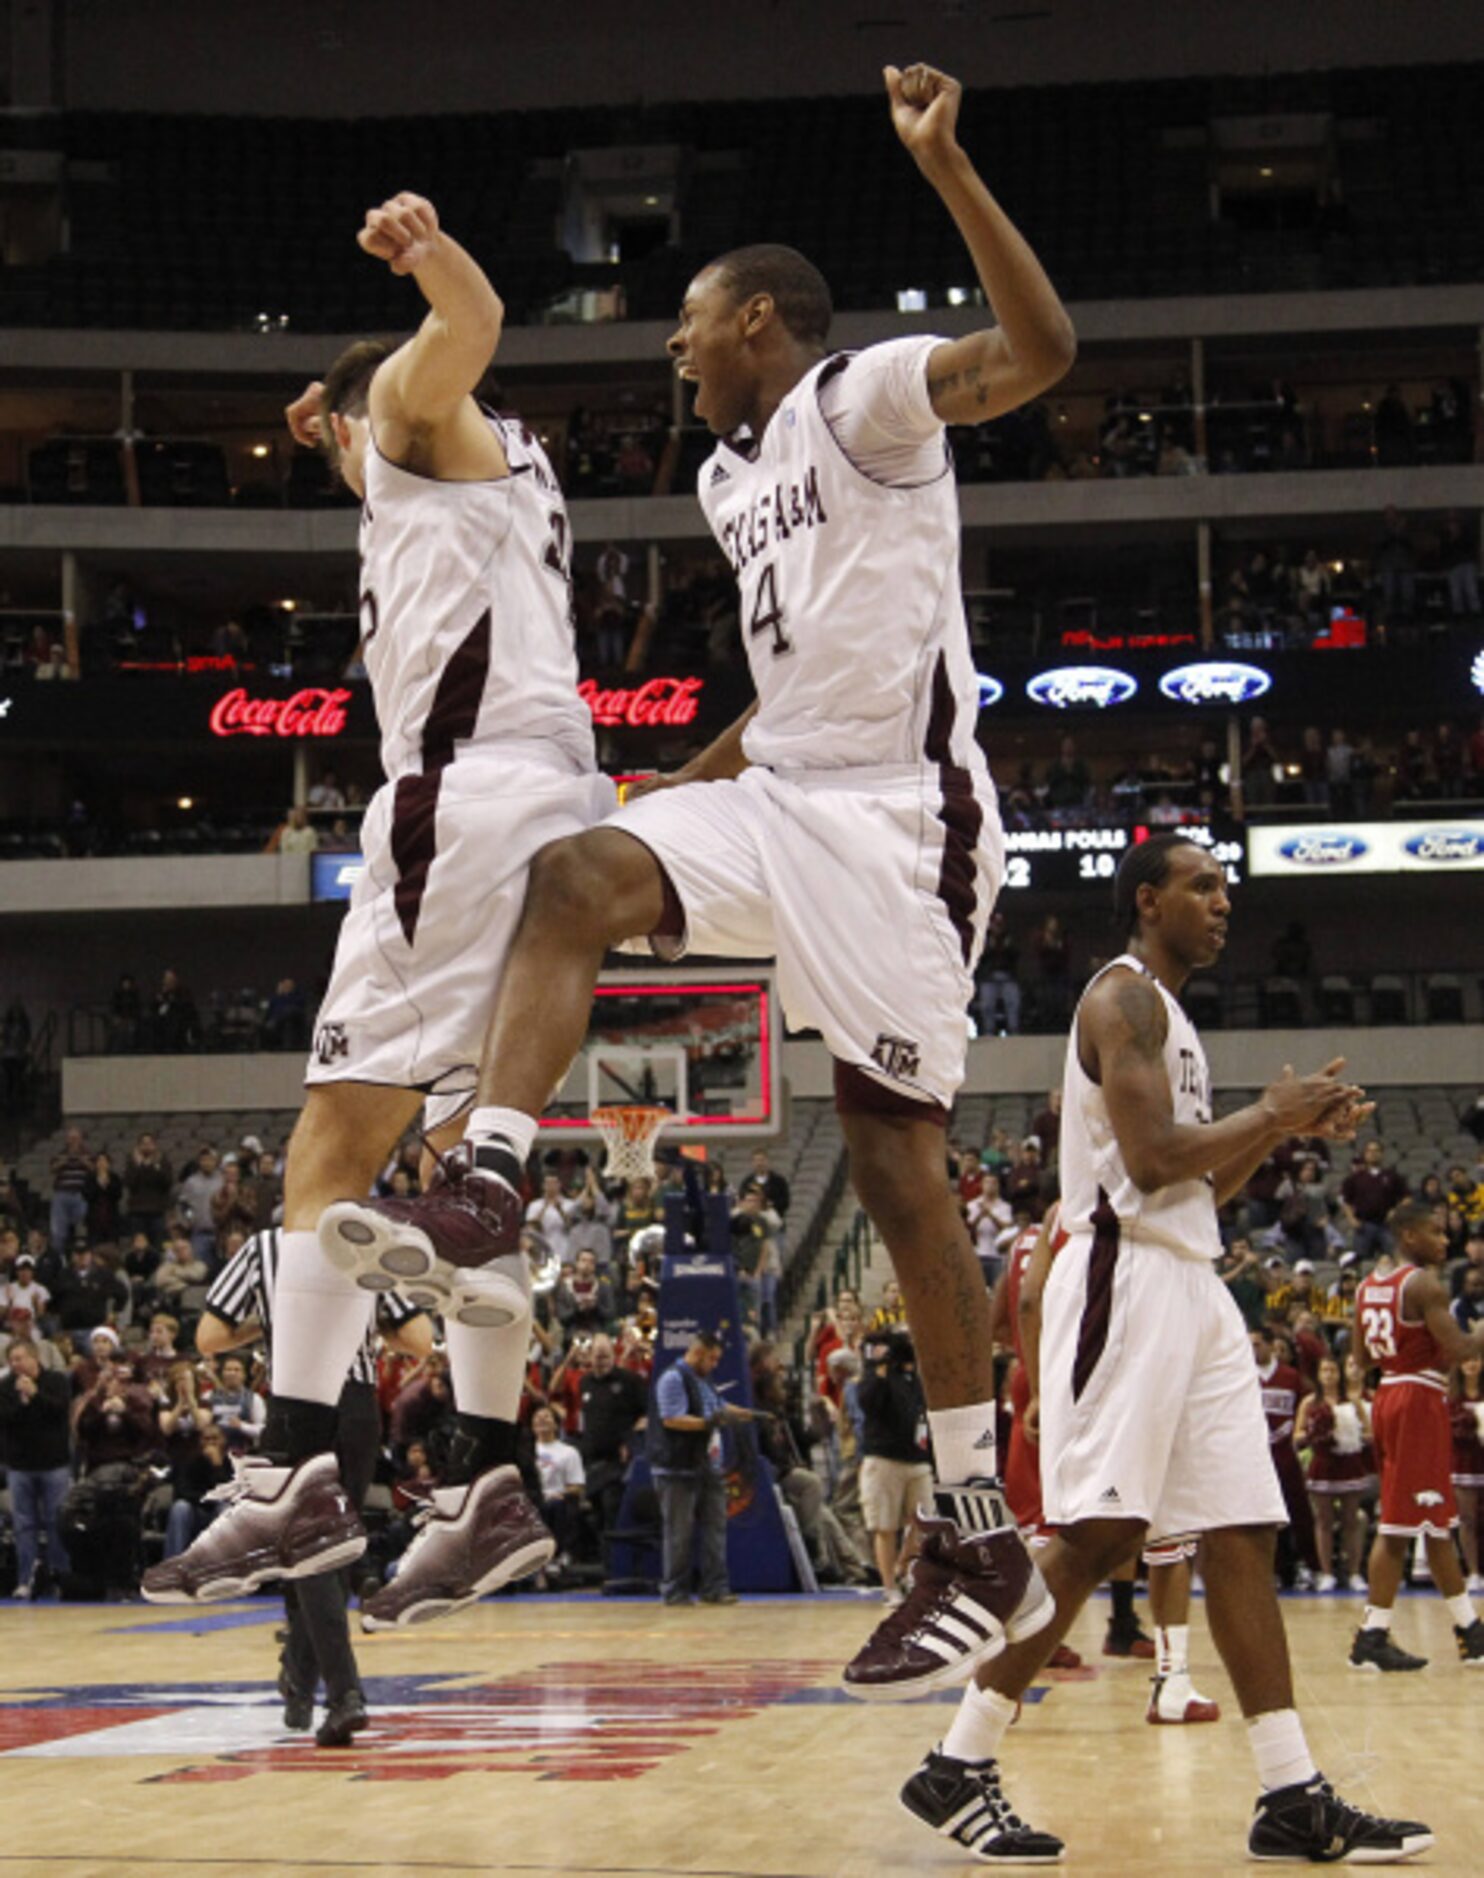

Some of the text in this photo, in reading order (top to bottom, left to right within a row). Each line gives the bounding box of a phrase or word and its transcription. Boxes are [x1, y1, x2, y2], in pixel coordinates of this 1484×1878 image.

[751, 563, 791, 655] 4
[1291, 836, 1354, 864] Ford
[1416, 832, 1480, 860] Ford
[1361, 1307, 1397, 1359] 23
